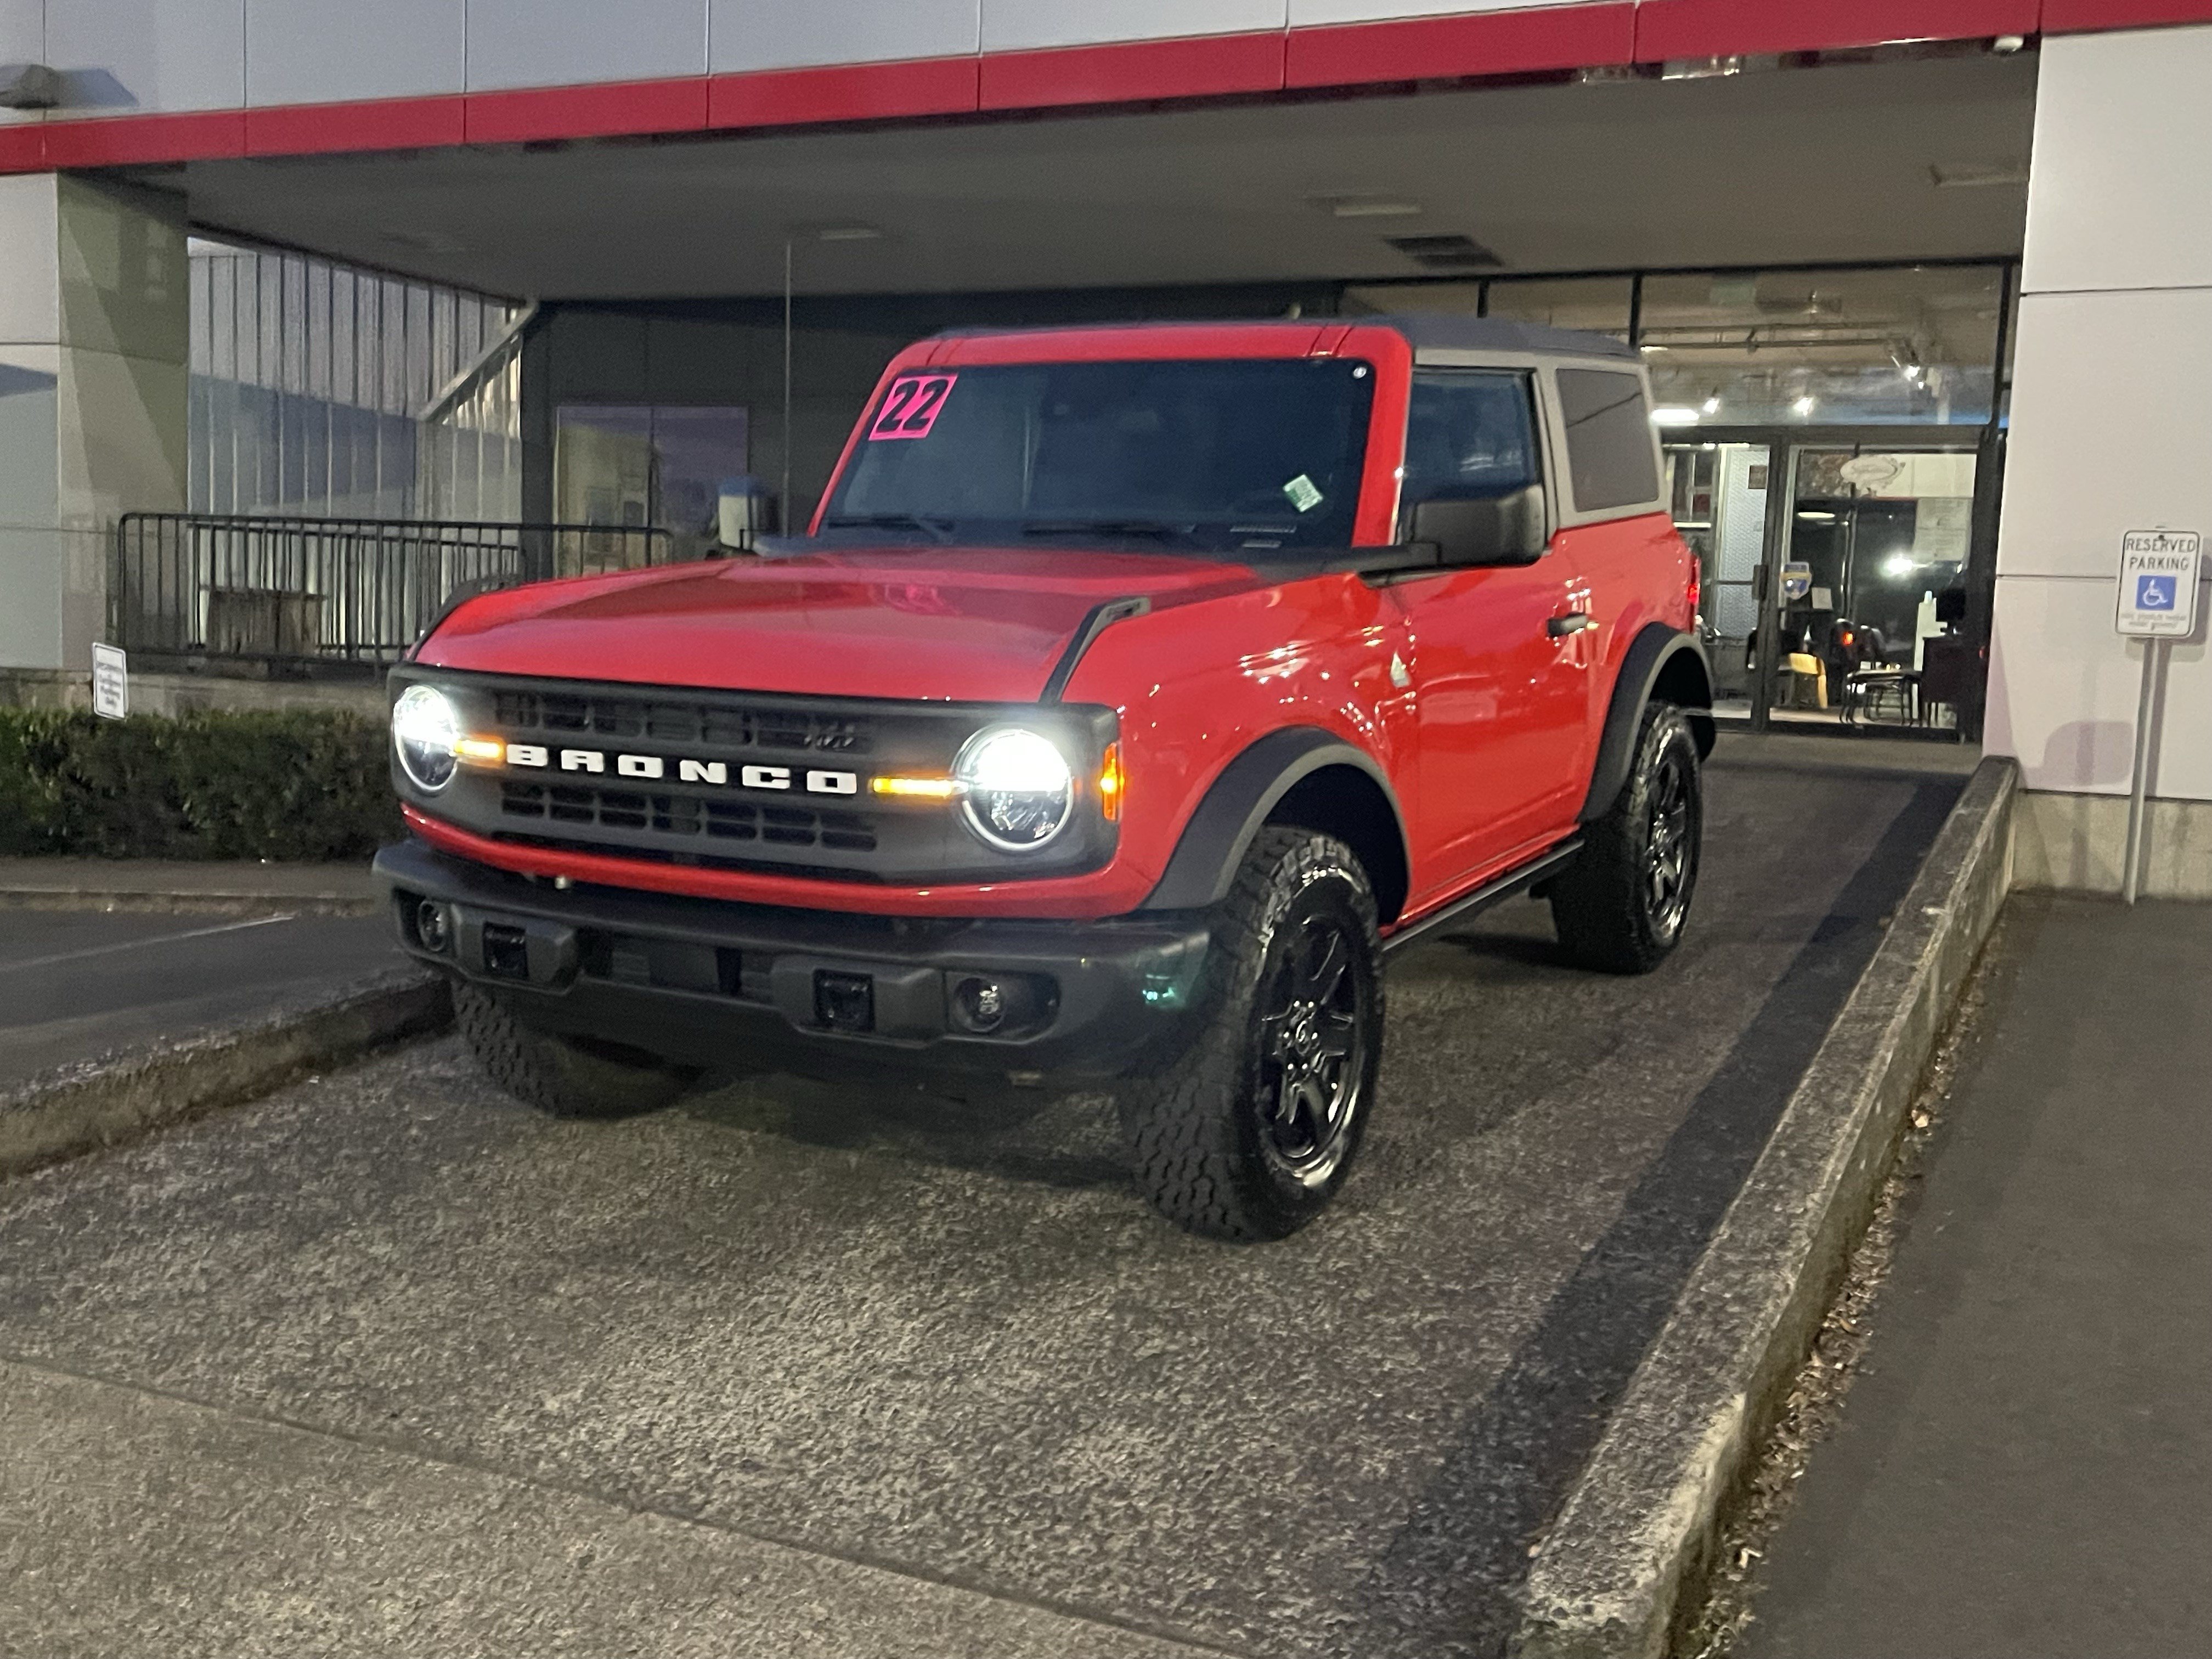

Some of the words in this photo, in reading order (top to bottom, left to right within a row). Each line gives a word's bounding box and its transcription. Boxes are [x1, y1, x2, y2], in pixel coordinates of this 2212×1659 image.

[876, 379, 949, 432] 22
[2126, 538, 2196, 552] RESERVED
[2129, 556, 2190, 571] PARKING
[506, 744, 857, 794] BRONCO
